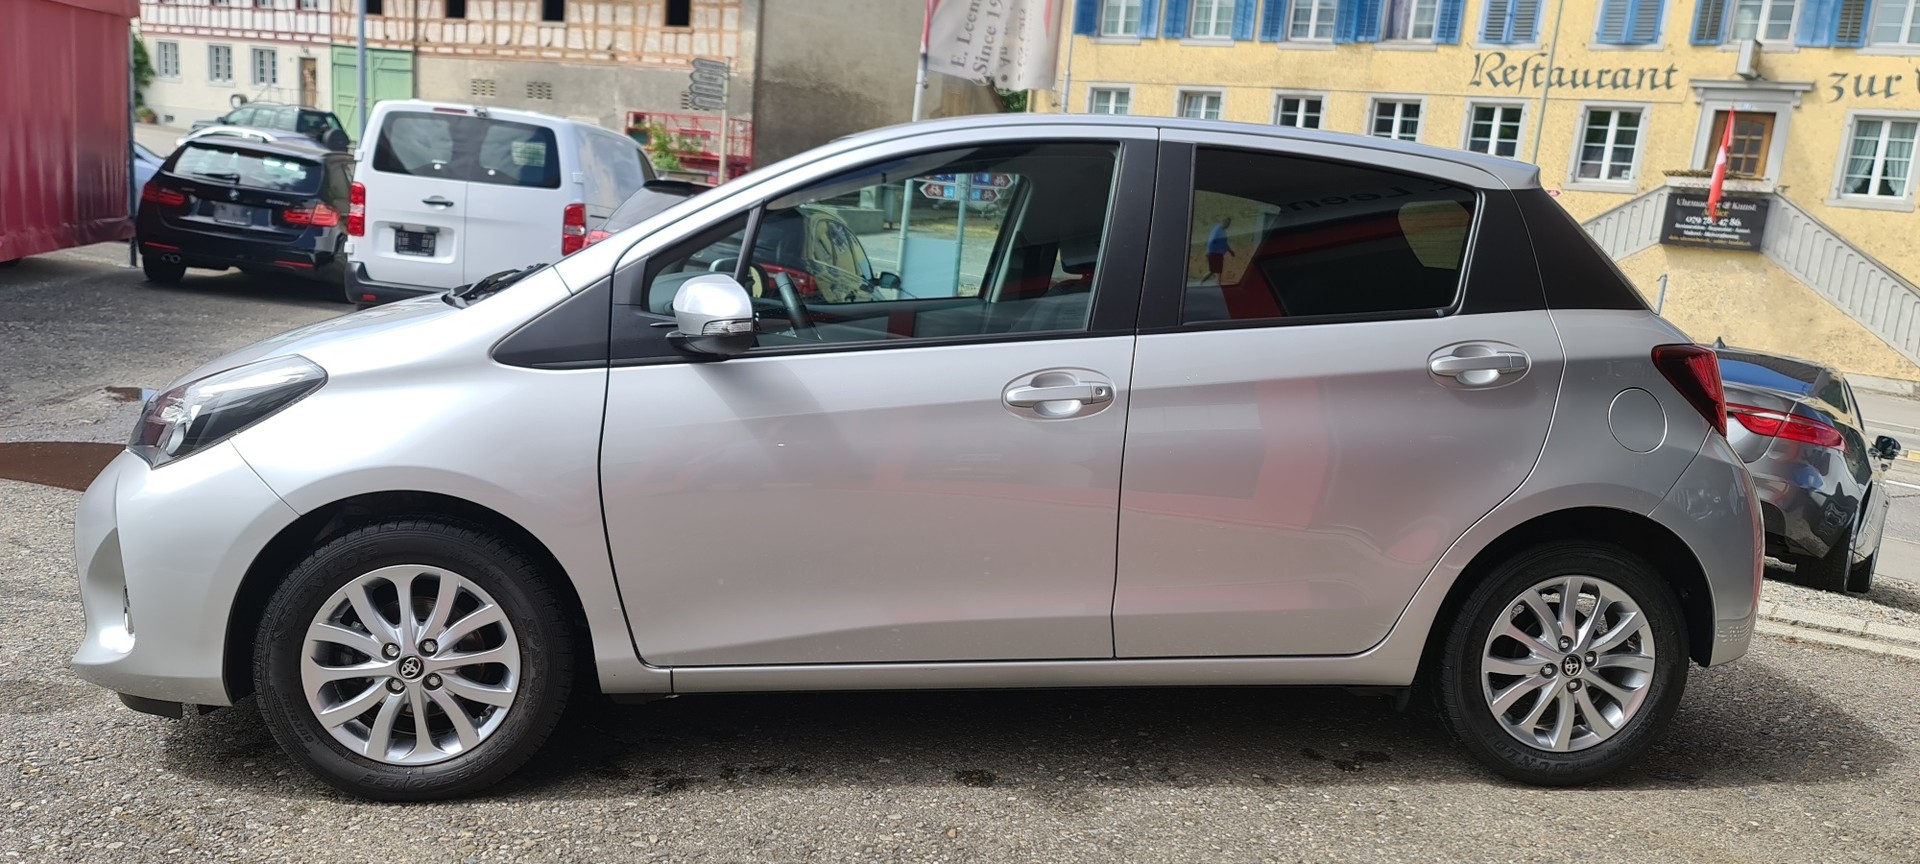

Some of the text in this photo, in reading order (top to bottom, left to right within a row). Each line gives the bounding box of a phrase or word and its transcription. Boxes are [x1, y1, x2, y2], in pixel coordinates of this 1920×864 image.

[951, 52, 968, 67] E.
[972, 25, 998, 75] Since
[1827, 72, 1902, 104] zur
